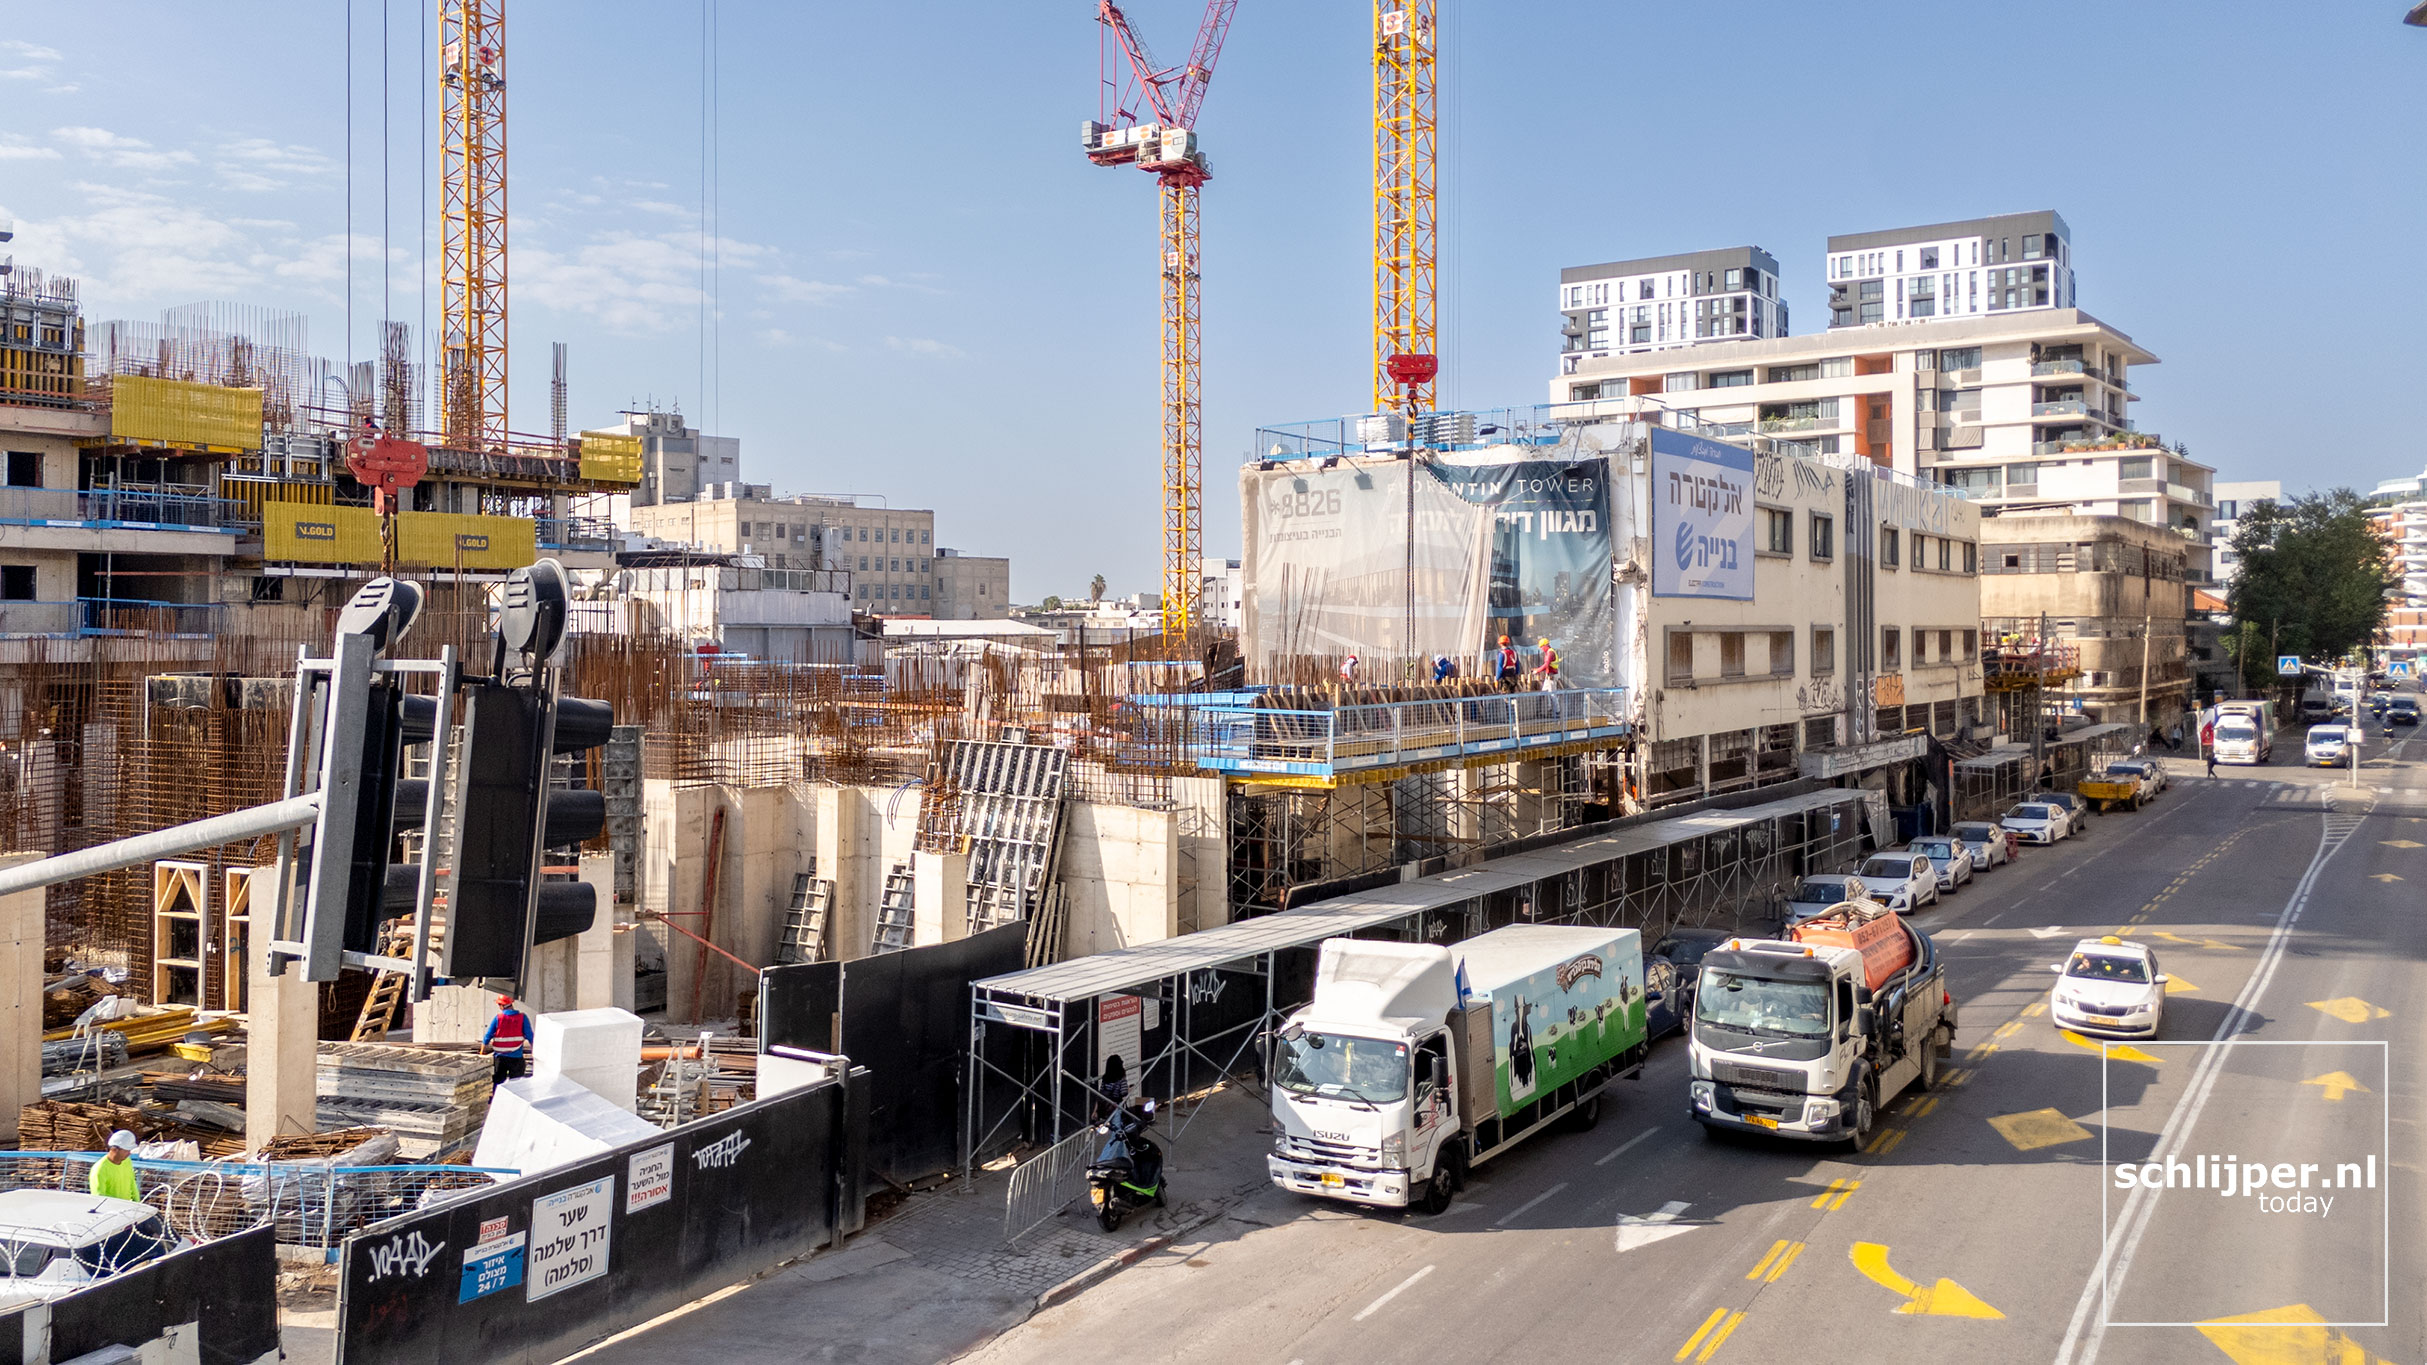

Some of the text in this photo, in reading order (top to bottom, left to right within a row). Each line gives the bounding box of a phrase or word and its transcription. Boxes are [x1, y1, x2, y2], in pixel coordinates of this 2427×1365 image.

[1517, 478, 1594, 493] TOWER
[1670, 472, 1742, 516] אלקטרה
[299, 526, 333, 538] V.GOLD
[1540, 510, 1597, 540] מגוון
[1311, 528, 1342, 541] הבנייה
[1698, 536, 1738, 570] בנייה
[1313, 1130, 1350, 1142] ISUZU
[639, 1162, 662, 1176] החניה
[632, 1172, 670, 1190] מול השער
[631, 1184, 668, 1204] אסורה!!!
[559, 1205, 588, 1228] שער
[534, 1225, 606, 1263] דרך שלמה
[482, 1255, 506, 1270] איזור
[544, 1254, 593, 1287] (סלמה)
[478, 1265, 507, 1282] מצולם
